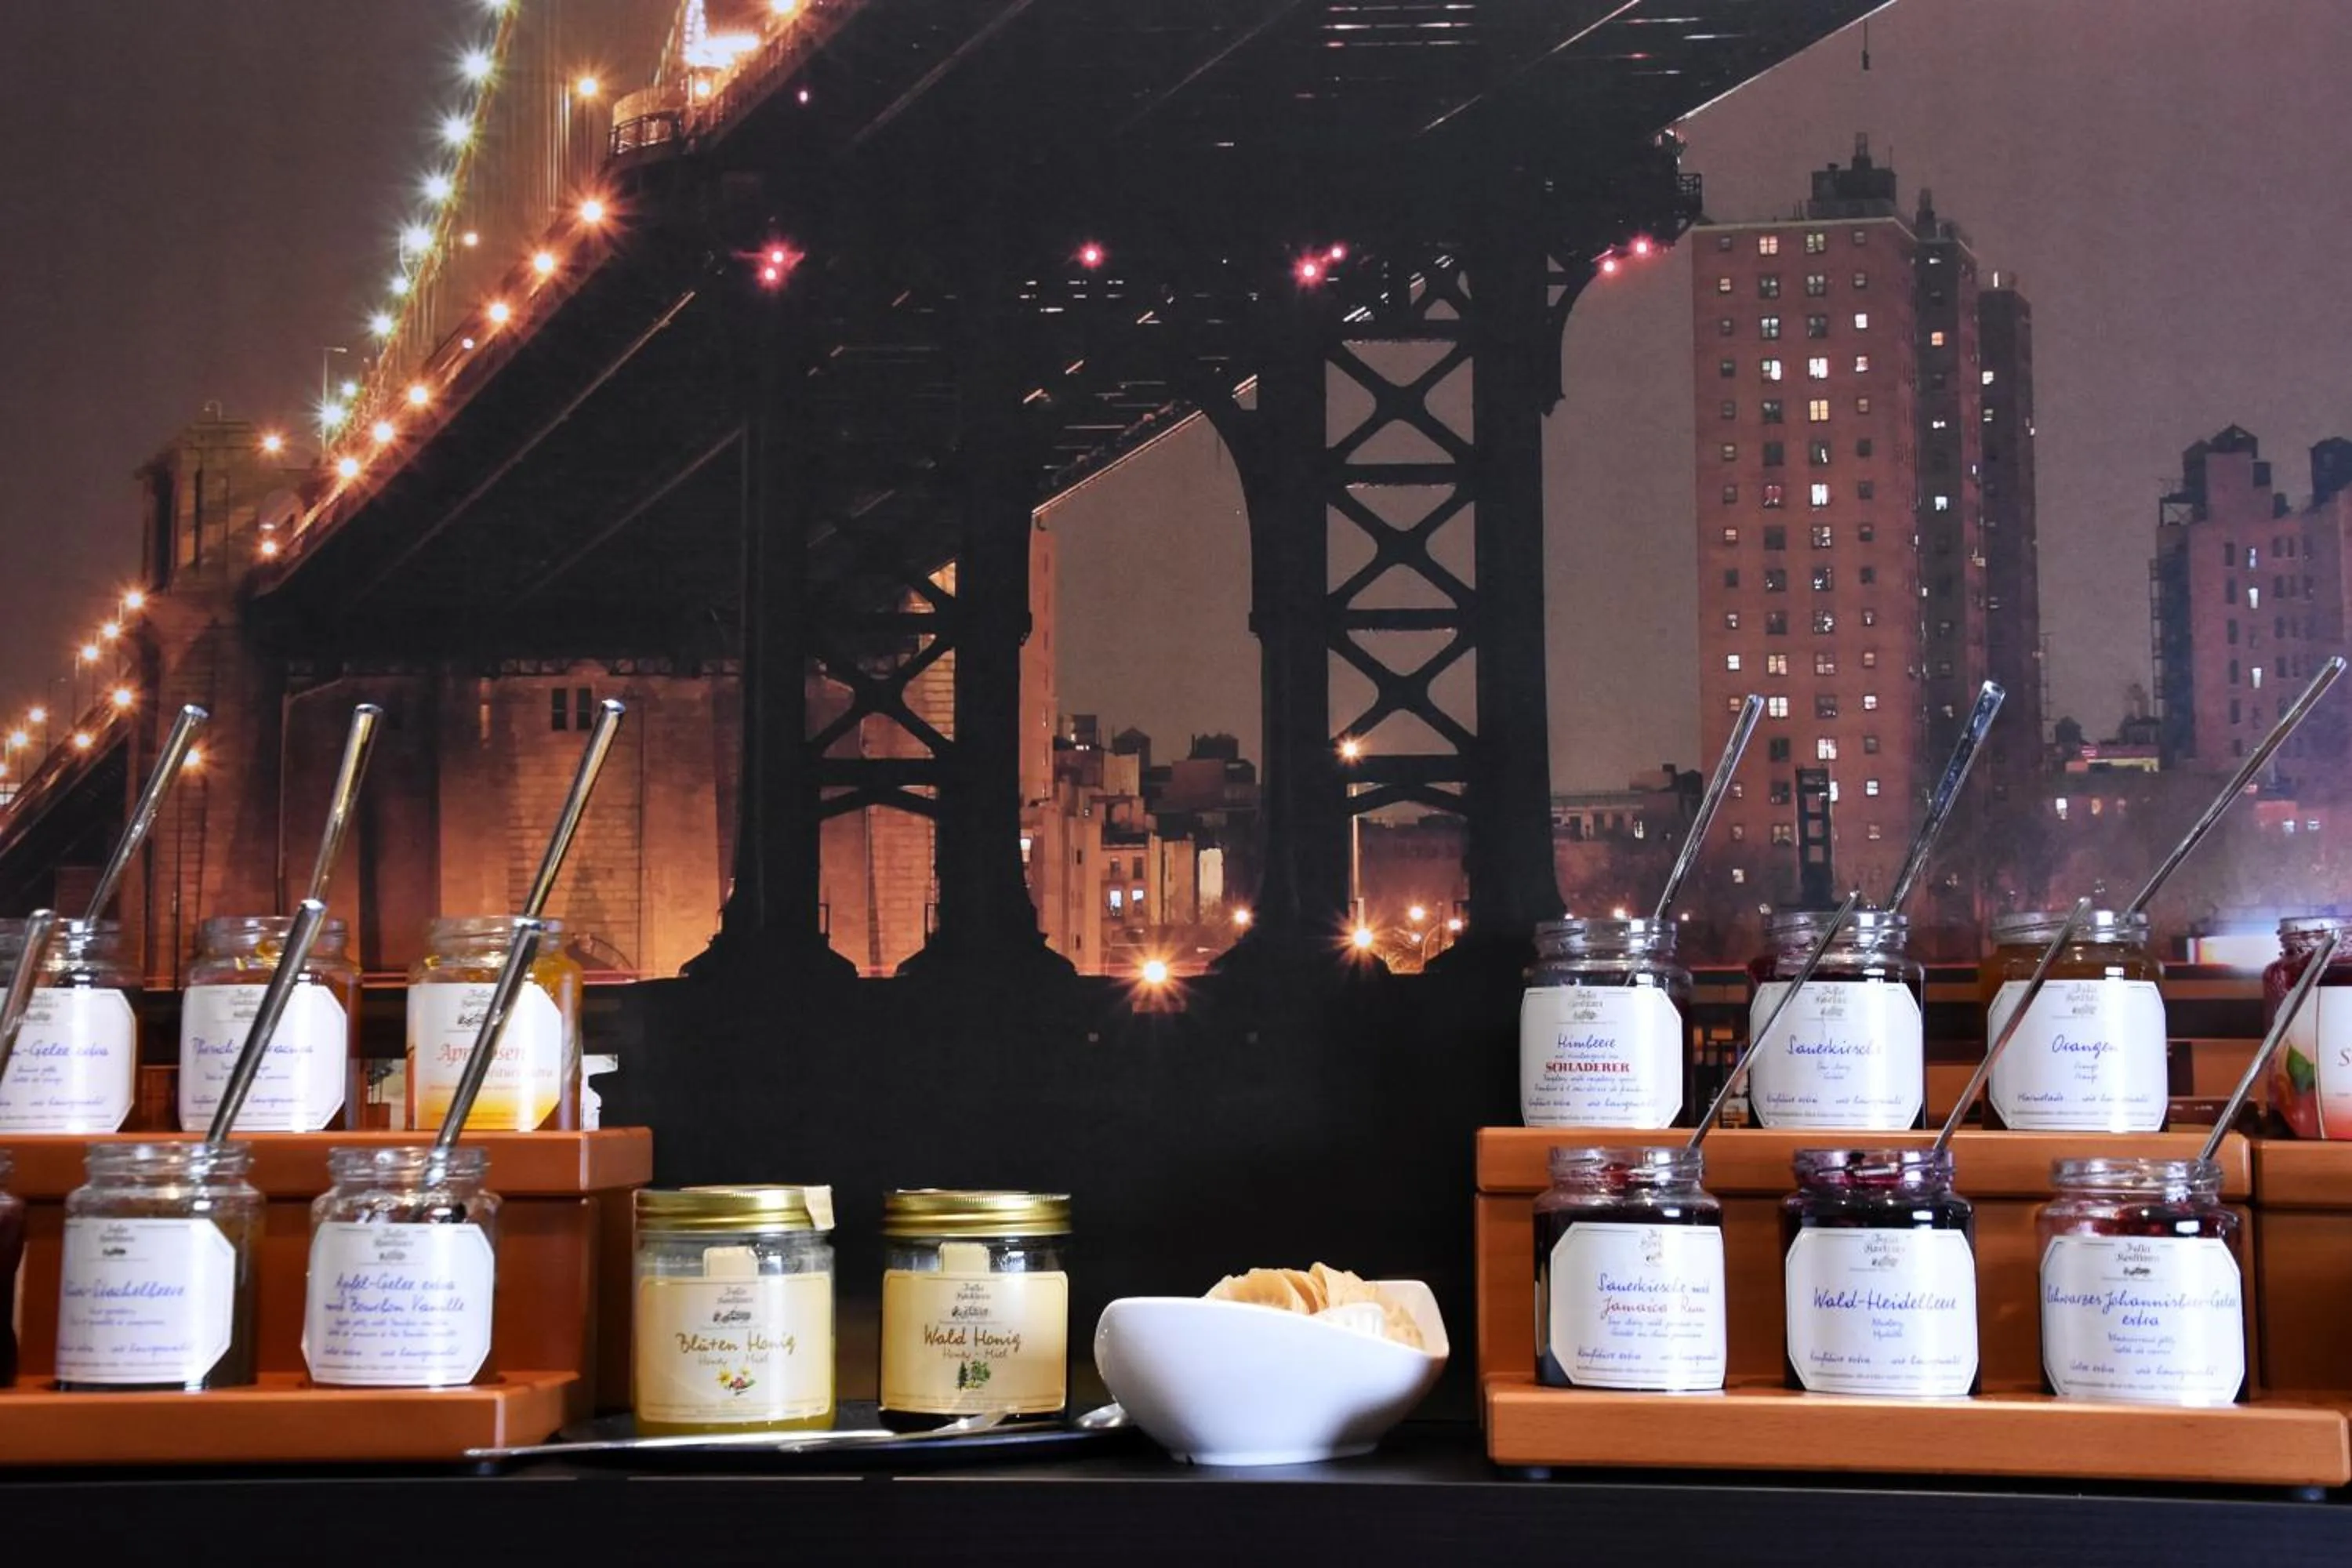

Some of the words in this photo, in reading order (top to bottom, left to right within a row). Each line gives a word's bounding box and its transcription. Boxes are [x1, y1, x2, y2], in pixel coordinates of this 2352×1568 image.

[1558, 1033, 1617, 1049] Himbeere
[1545, 1062, 1631, 1073] SCHLADERER
[2122, 1308, 2161, 1327] extra
[675, 1333, 739, 1353] Blüten
[746, 1330, 796, 1355] Honig
[924, 1324, 967, 1346] Wald
[975, 1325, 1022, 1353] Honig
